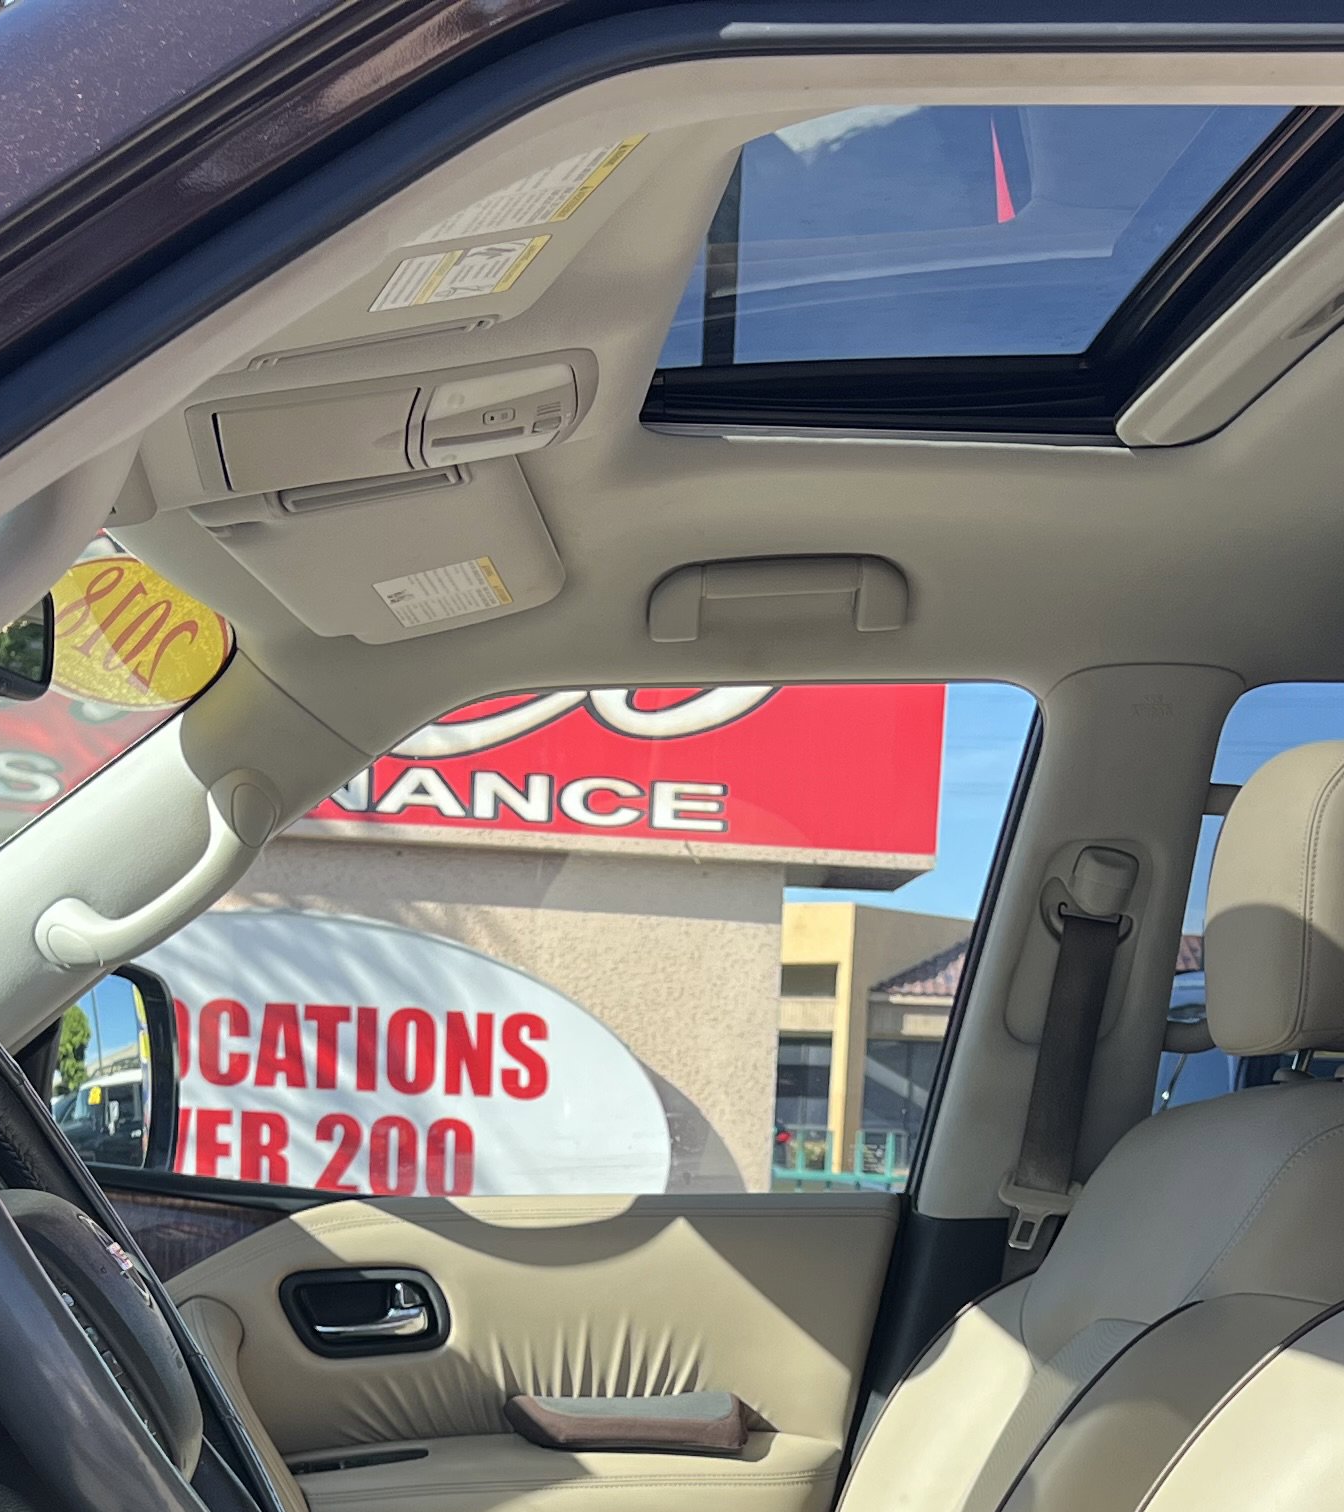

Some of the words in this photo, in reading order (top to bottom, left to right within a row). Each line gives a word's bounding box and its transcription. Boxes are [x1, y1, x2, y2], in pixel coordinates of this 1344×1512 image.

[328, 766, 729, 832] NANCE
[173, 998, 549, 1101] CATIONS
[314, 1112, 476, 1198] 200
